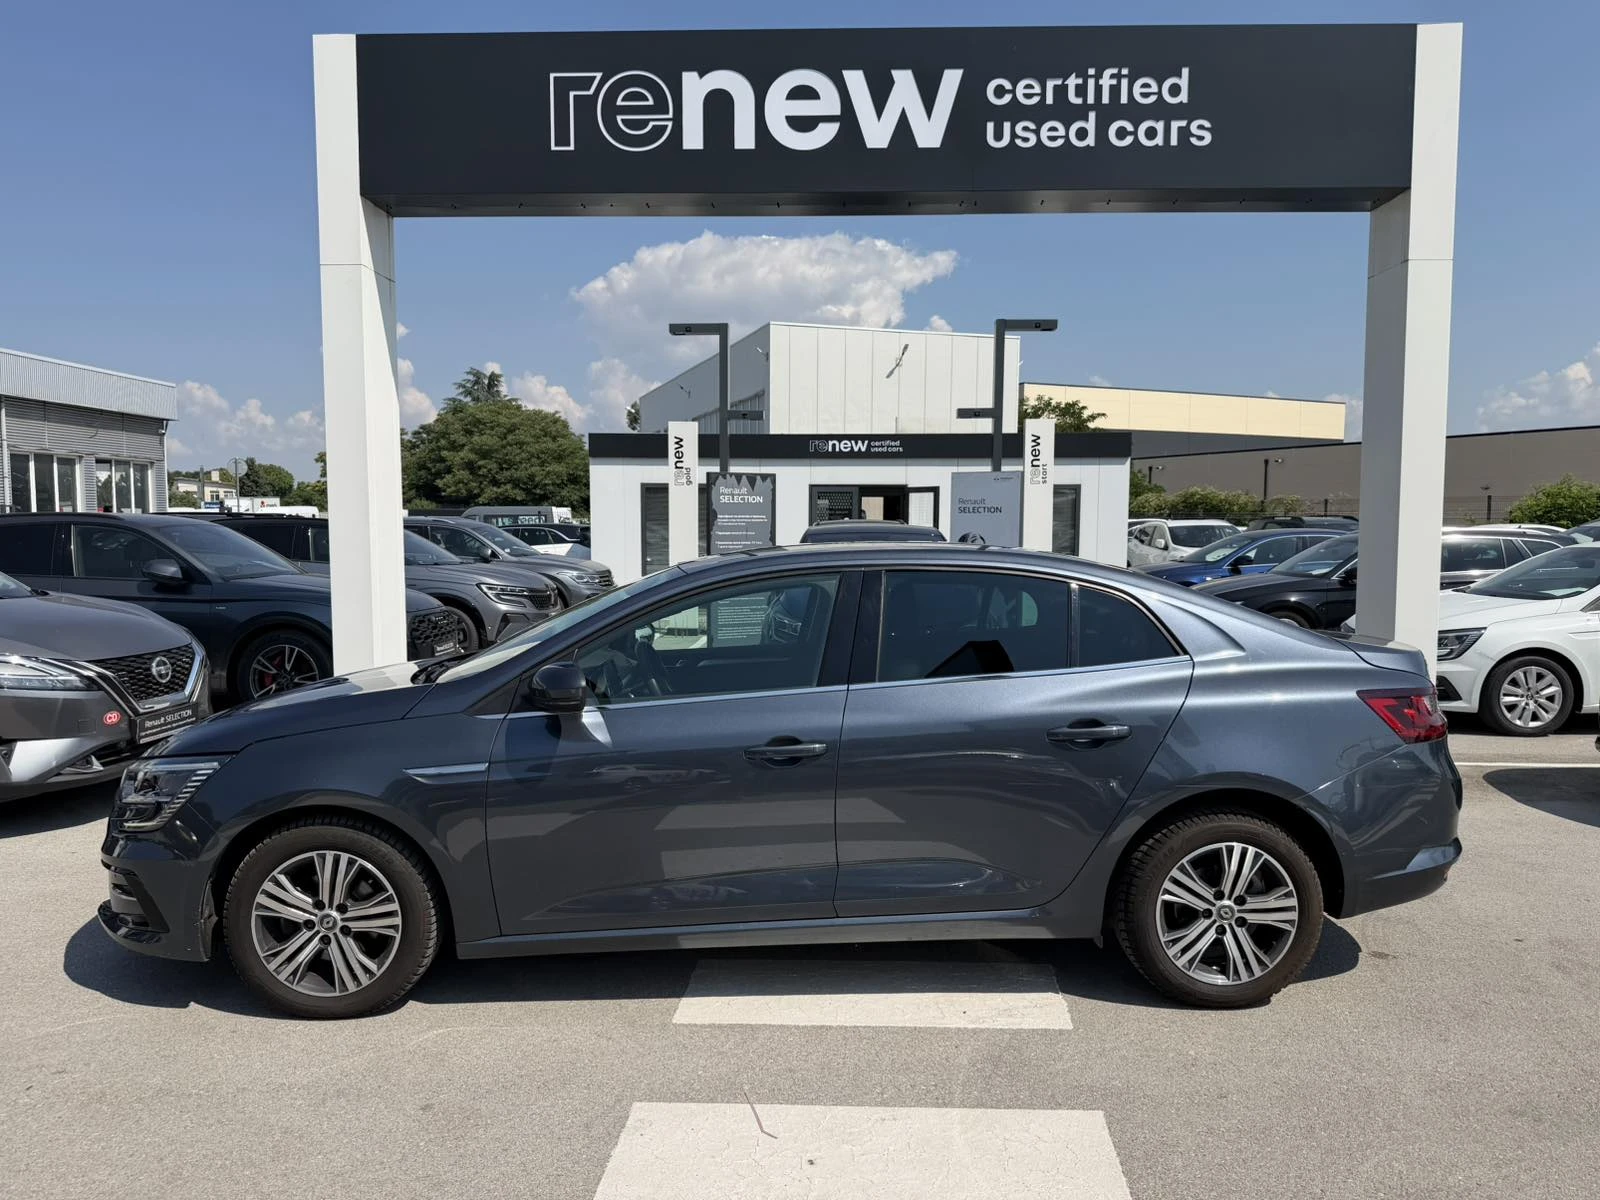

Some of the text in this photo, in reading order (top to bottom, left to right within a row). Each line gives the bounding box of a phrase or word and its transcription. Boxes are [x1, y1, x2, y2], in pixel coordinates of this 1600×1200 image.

[986, 67, 1190, 106] certified
[549, 68, 964, 152] renew
[986, 111, 1213, 148] used cars
[809, 439, 869, 453] renew
[673, 435, 684, 486] renew
[1030, 433, 1041, 485] renew
[684, 467, 693, 486] gold
[719, 486, 748, 495] Renault
[719, 495, 764, 503] SELECTION
[957, 506, 1002, 514] SELECTION
[958, 497, 986, 505] Renault
[144, 709, 193, 729] Renault SELECTION
